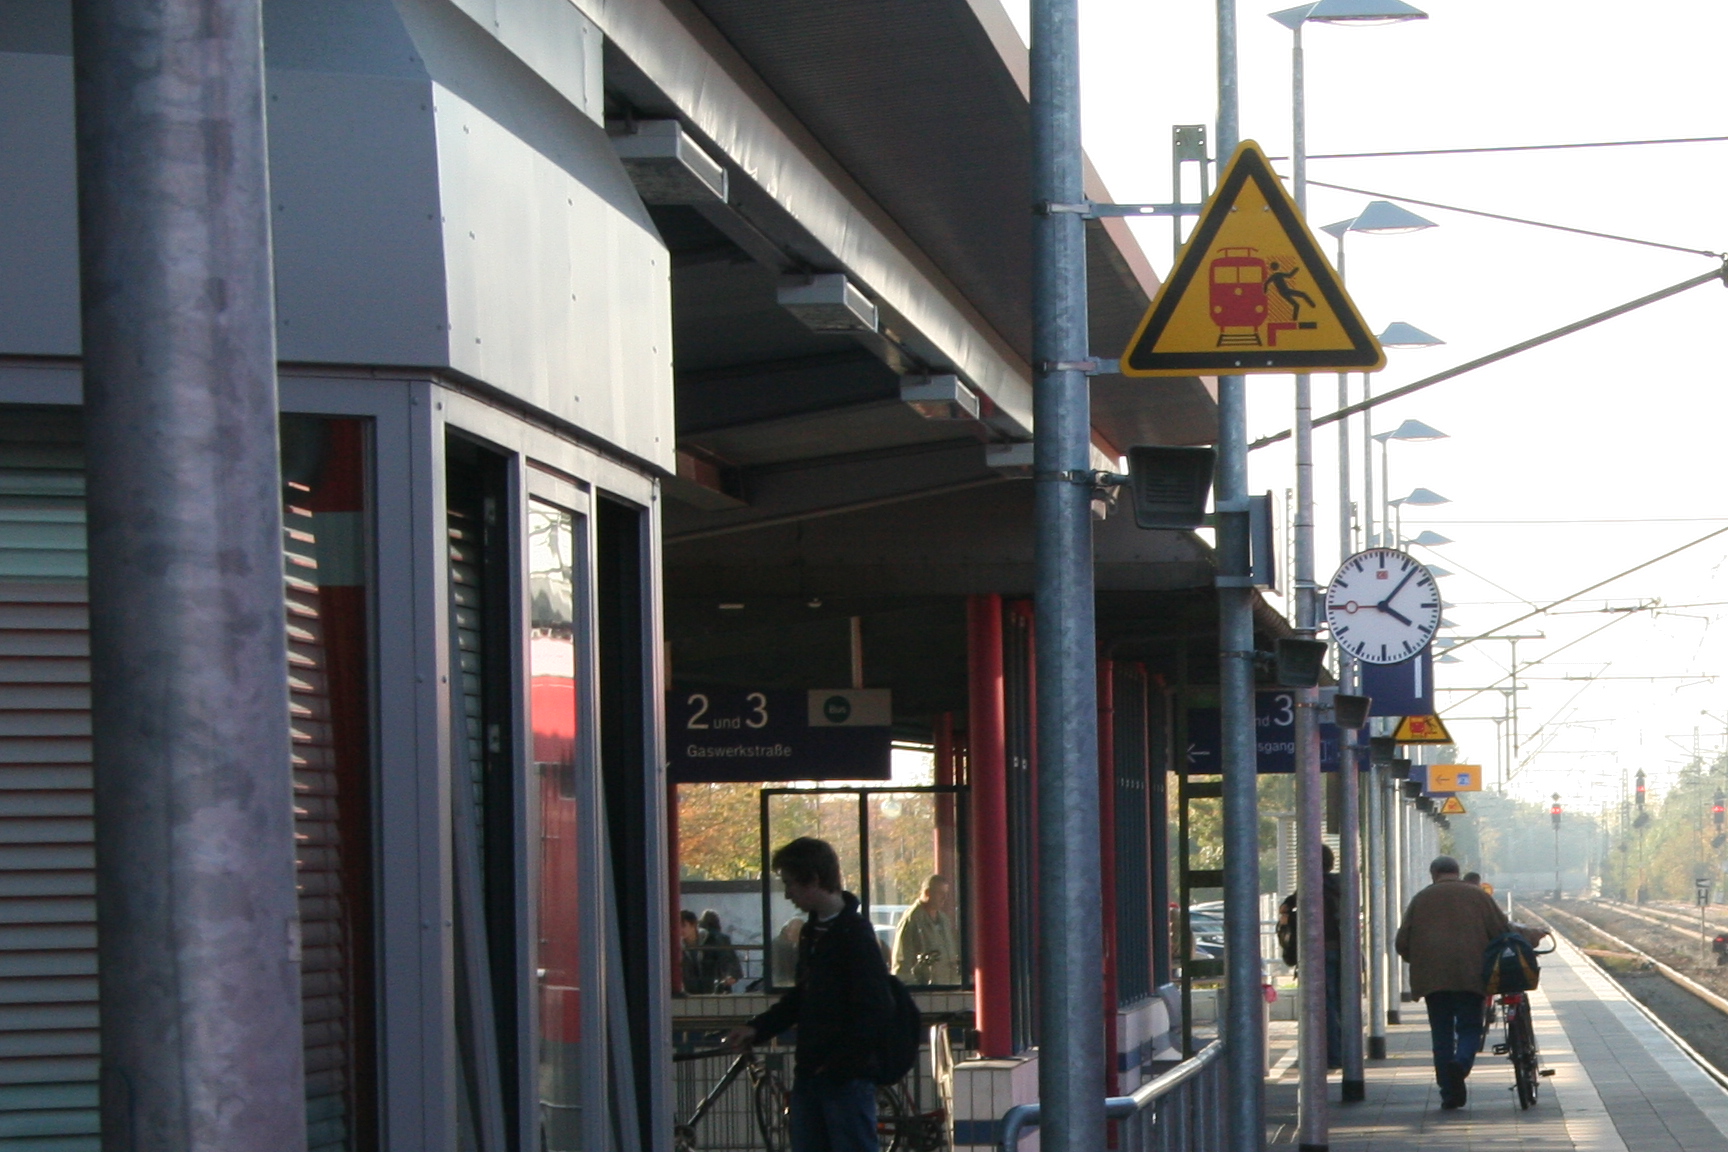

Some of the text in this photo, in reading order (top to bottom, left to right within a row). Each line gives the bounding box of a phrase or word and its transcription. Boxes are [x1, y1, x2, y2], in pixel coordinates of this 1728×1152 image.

[686, 692, 769, 729] 2 und 3
[1255, 694, 1294, 727] nd 3
[686, 743, 792, 758] Gaswerkstraße
[1257, 741, 1295, 755] sgang
